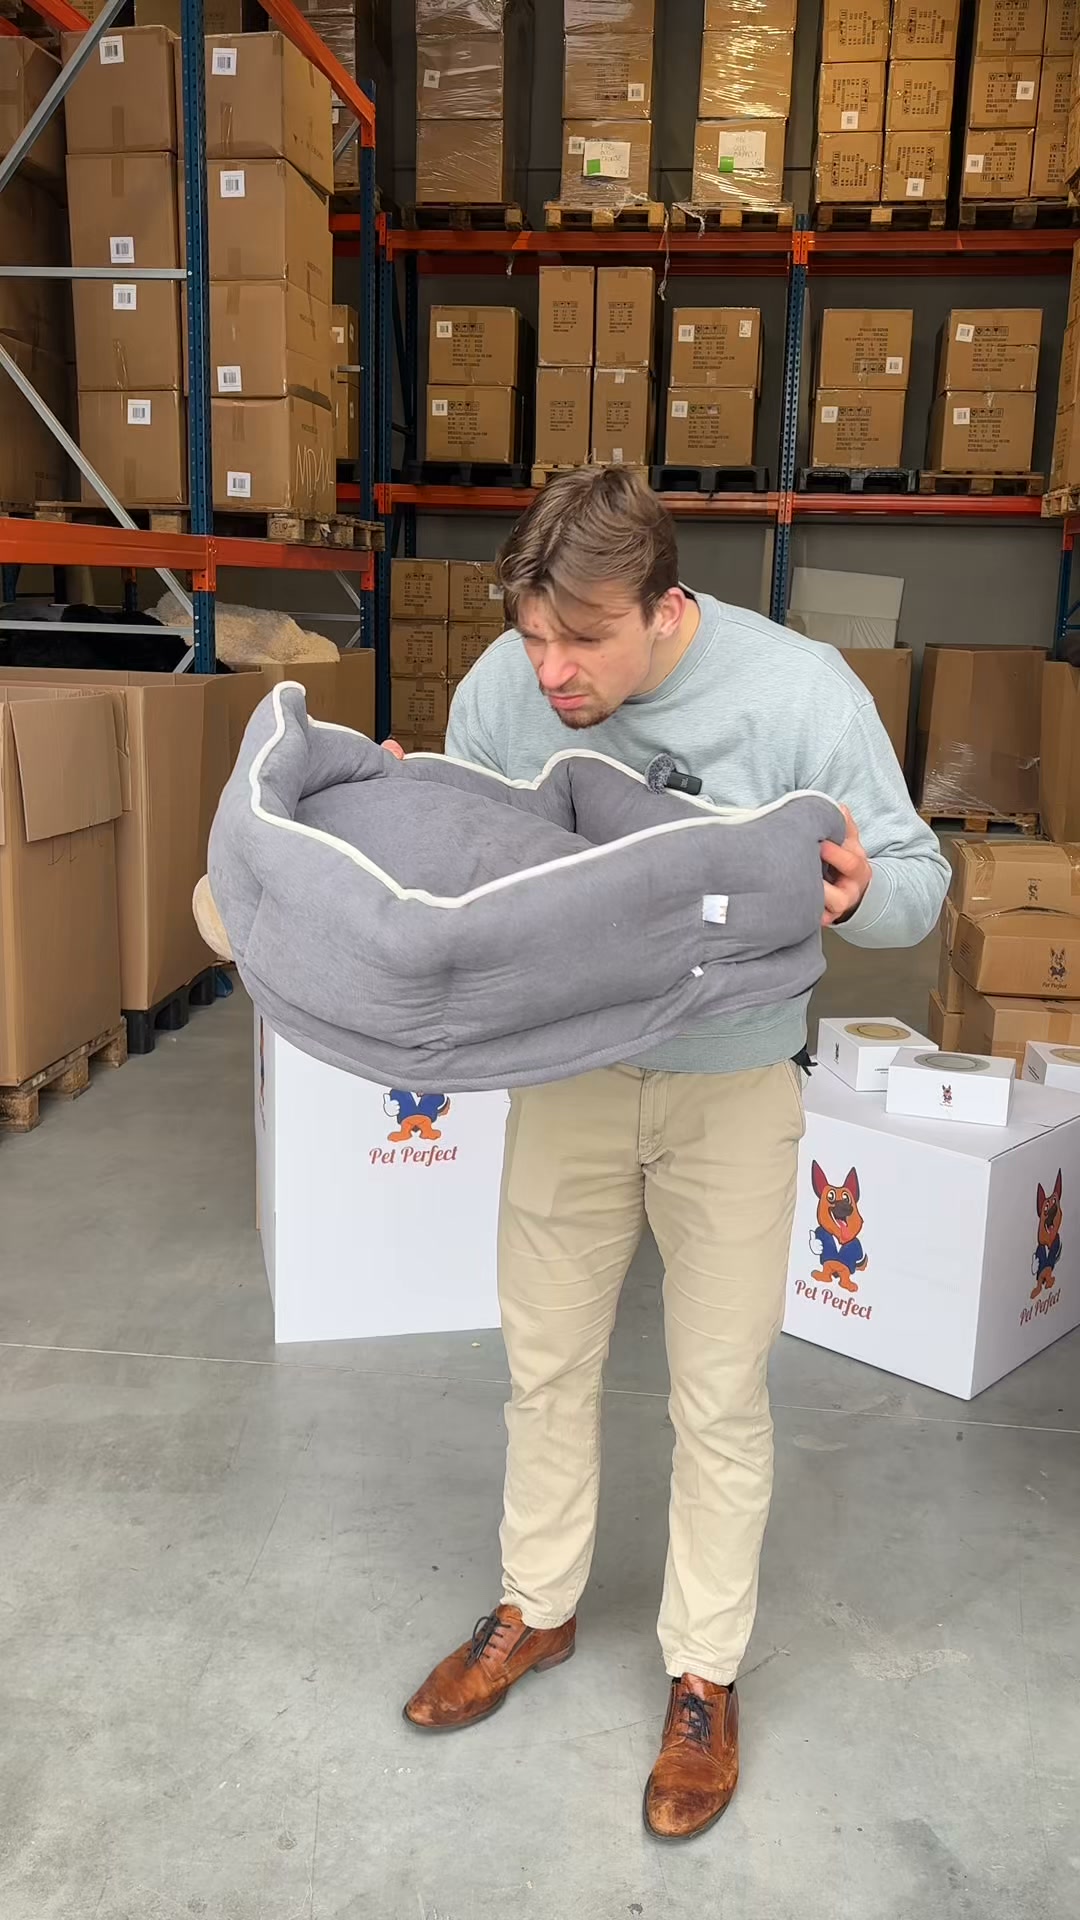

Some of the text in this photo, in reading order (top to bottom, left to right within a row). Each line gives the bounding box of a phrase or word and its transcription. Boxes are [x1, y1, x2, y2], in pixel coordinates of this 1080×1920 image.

[369, 1145, 458, 1167] Pet Perfect
[795, 1279, 872, 1320] Pet Perfect
[1020, 1288, 1061, 1326] Pet Perfect
